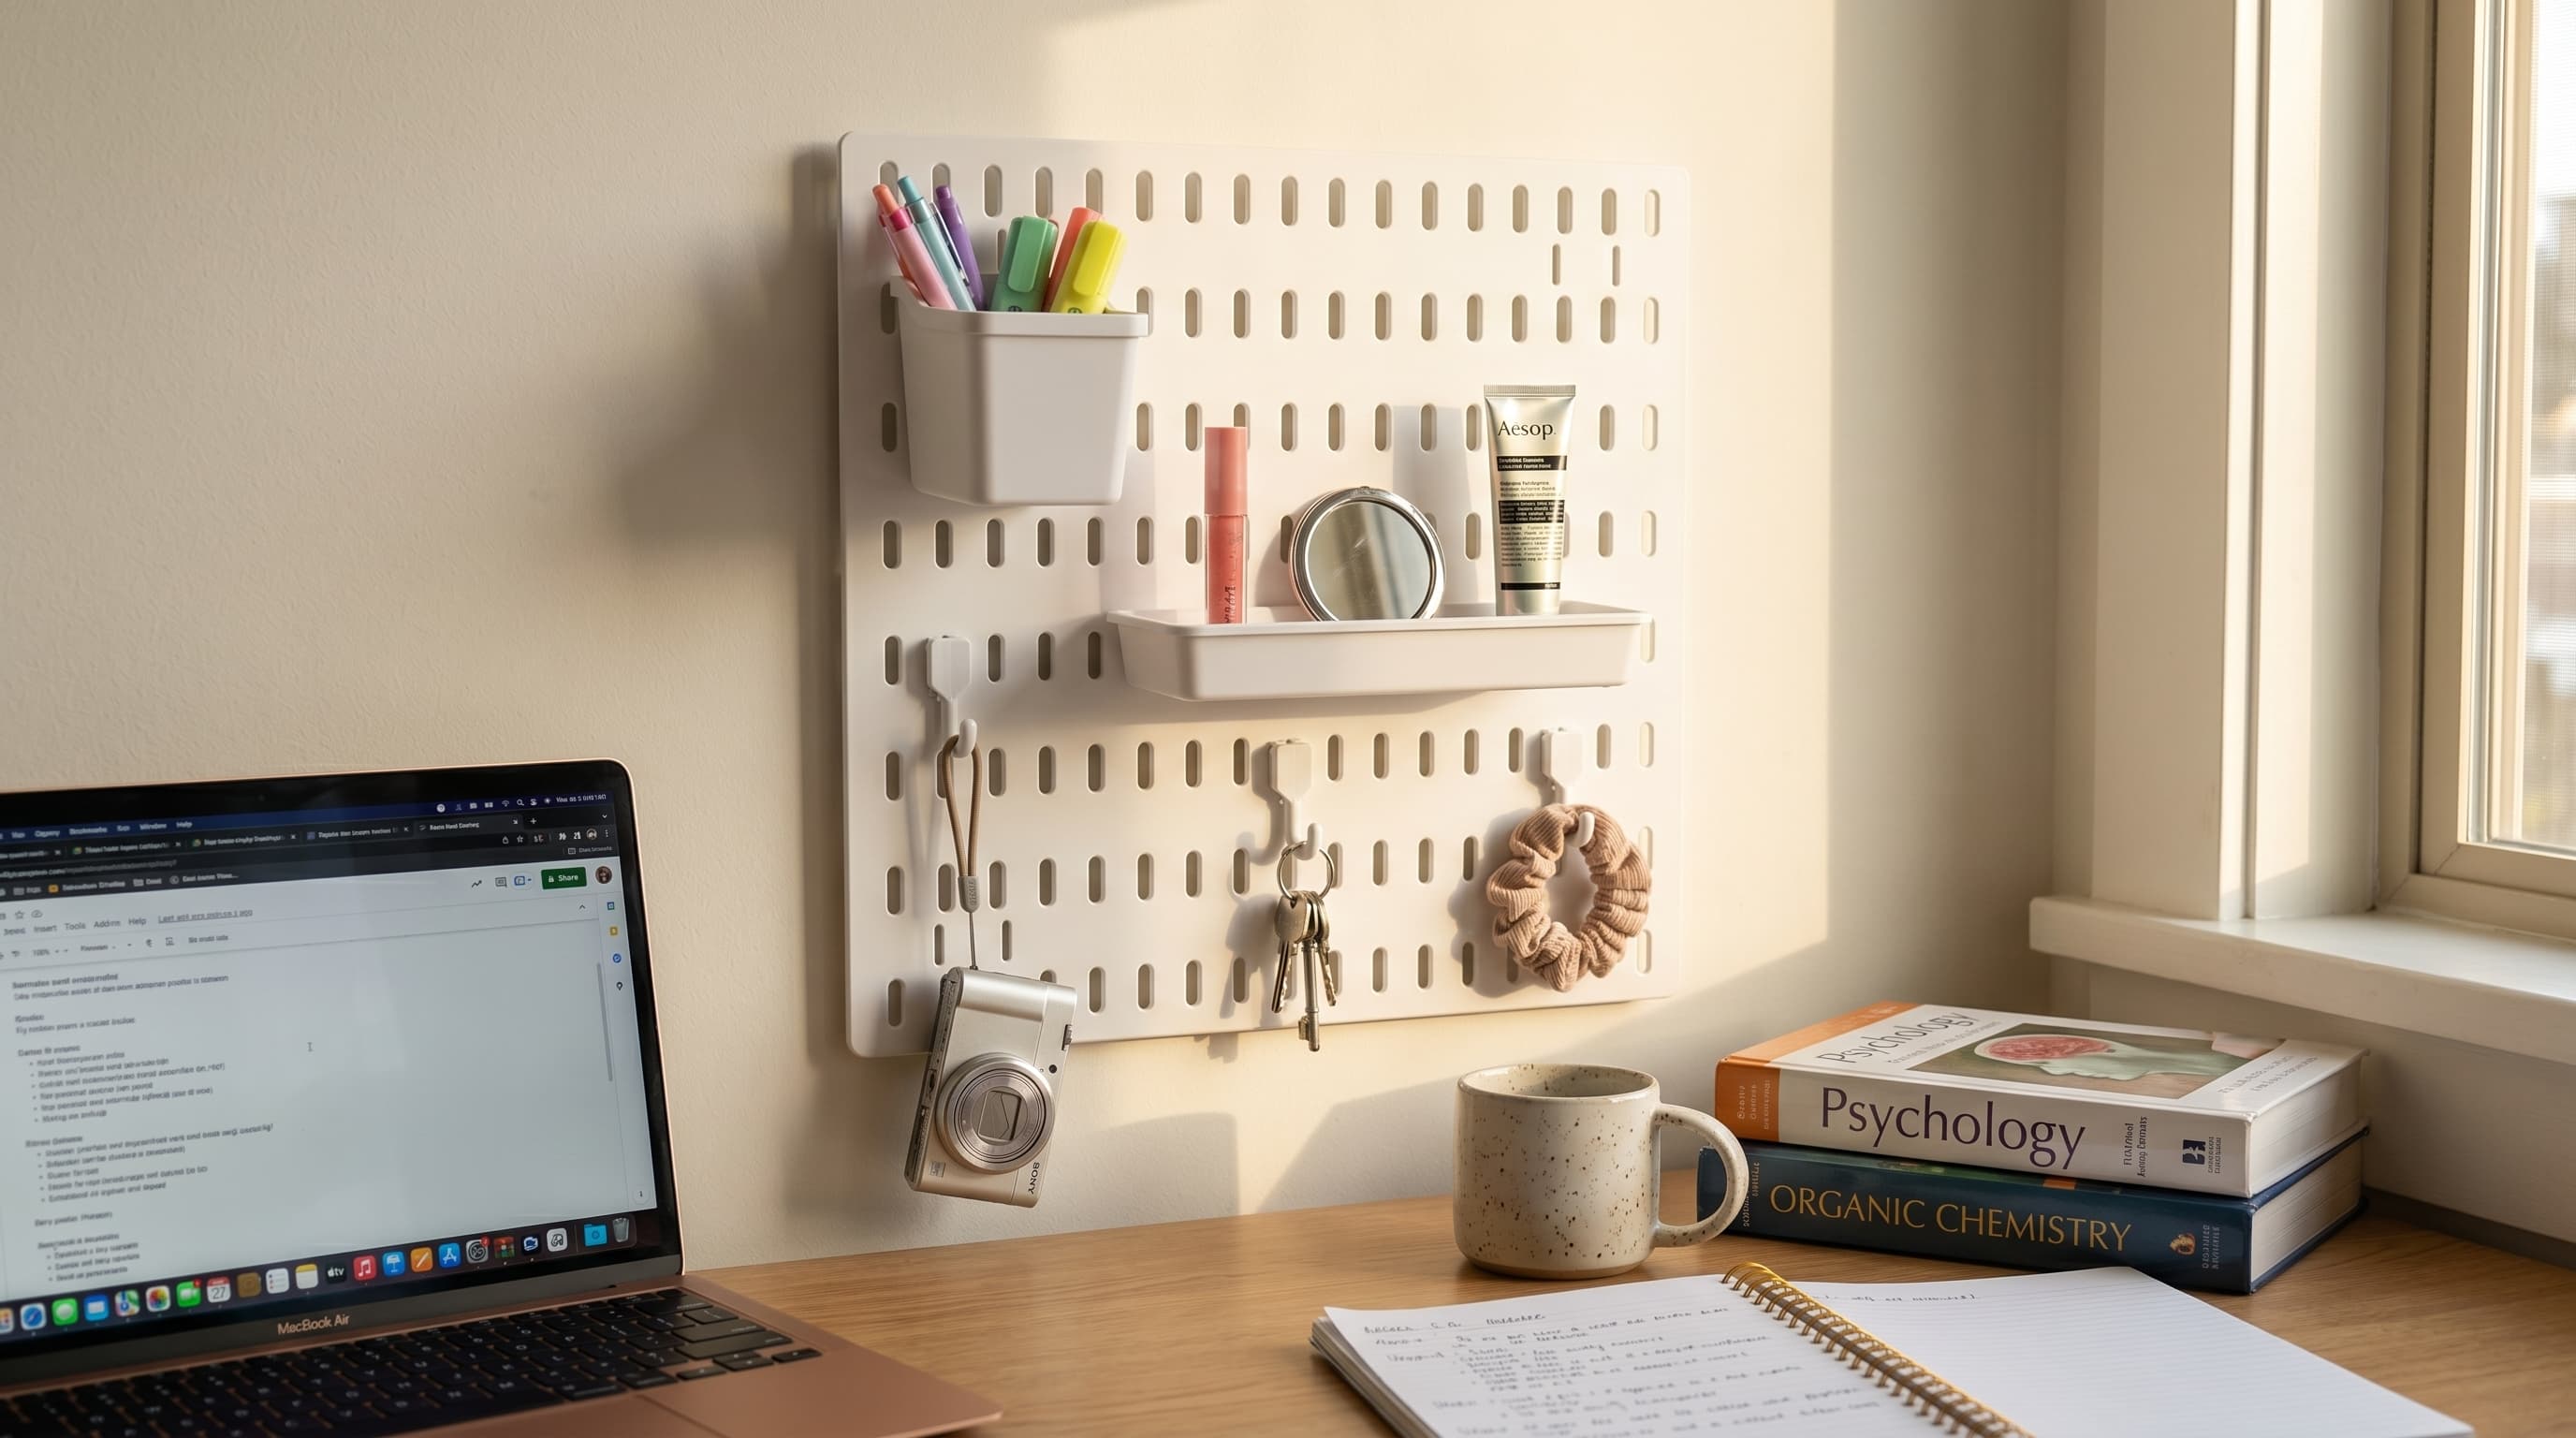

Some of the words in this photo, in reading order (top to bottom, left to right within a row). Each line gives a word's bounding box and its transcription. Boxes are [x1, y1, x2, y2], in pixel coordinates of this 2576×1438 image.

[1816, 1012, 1980, 1064] Psychology
[1822, 1087, 2086, 1169] Psychology
[1028, 1162, 1040, 1195] SONY
[1770, 1184, 1925, 1228] ORGANIC
[1935, 1203, 2133, 1253] CHEMISTRY
[212, 1286, 226, 1299] 27
[334, 1313, 351, 1326] Air
